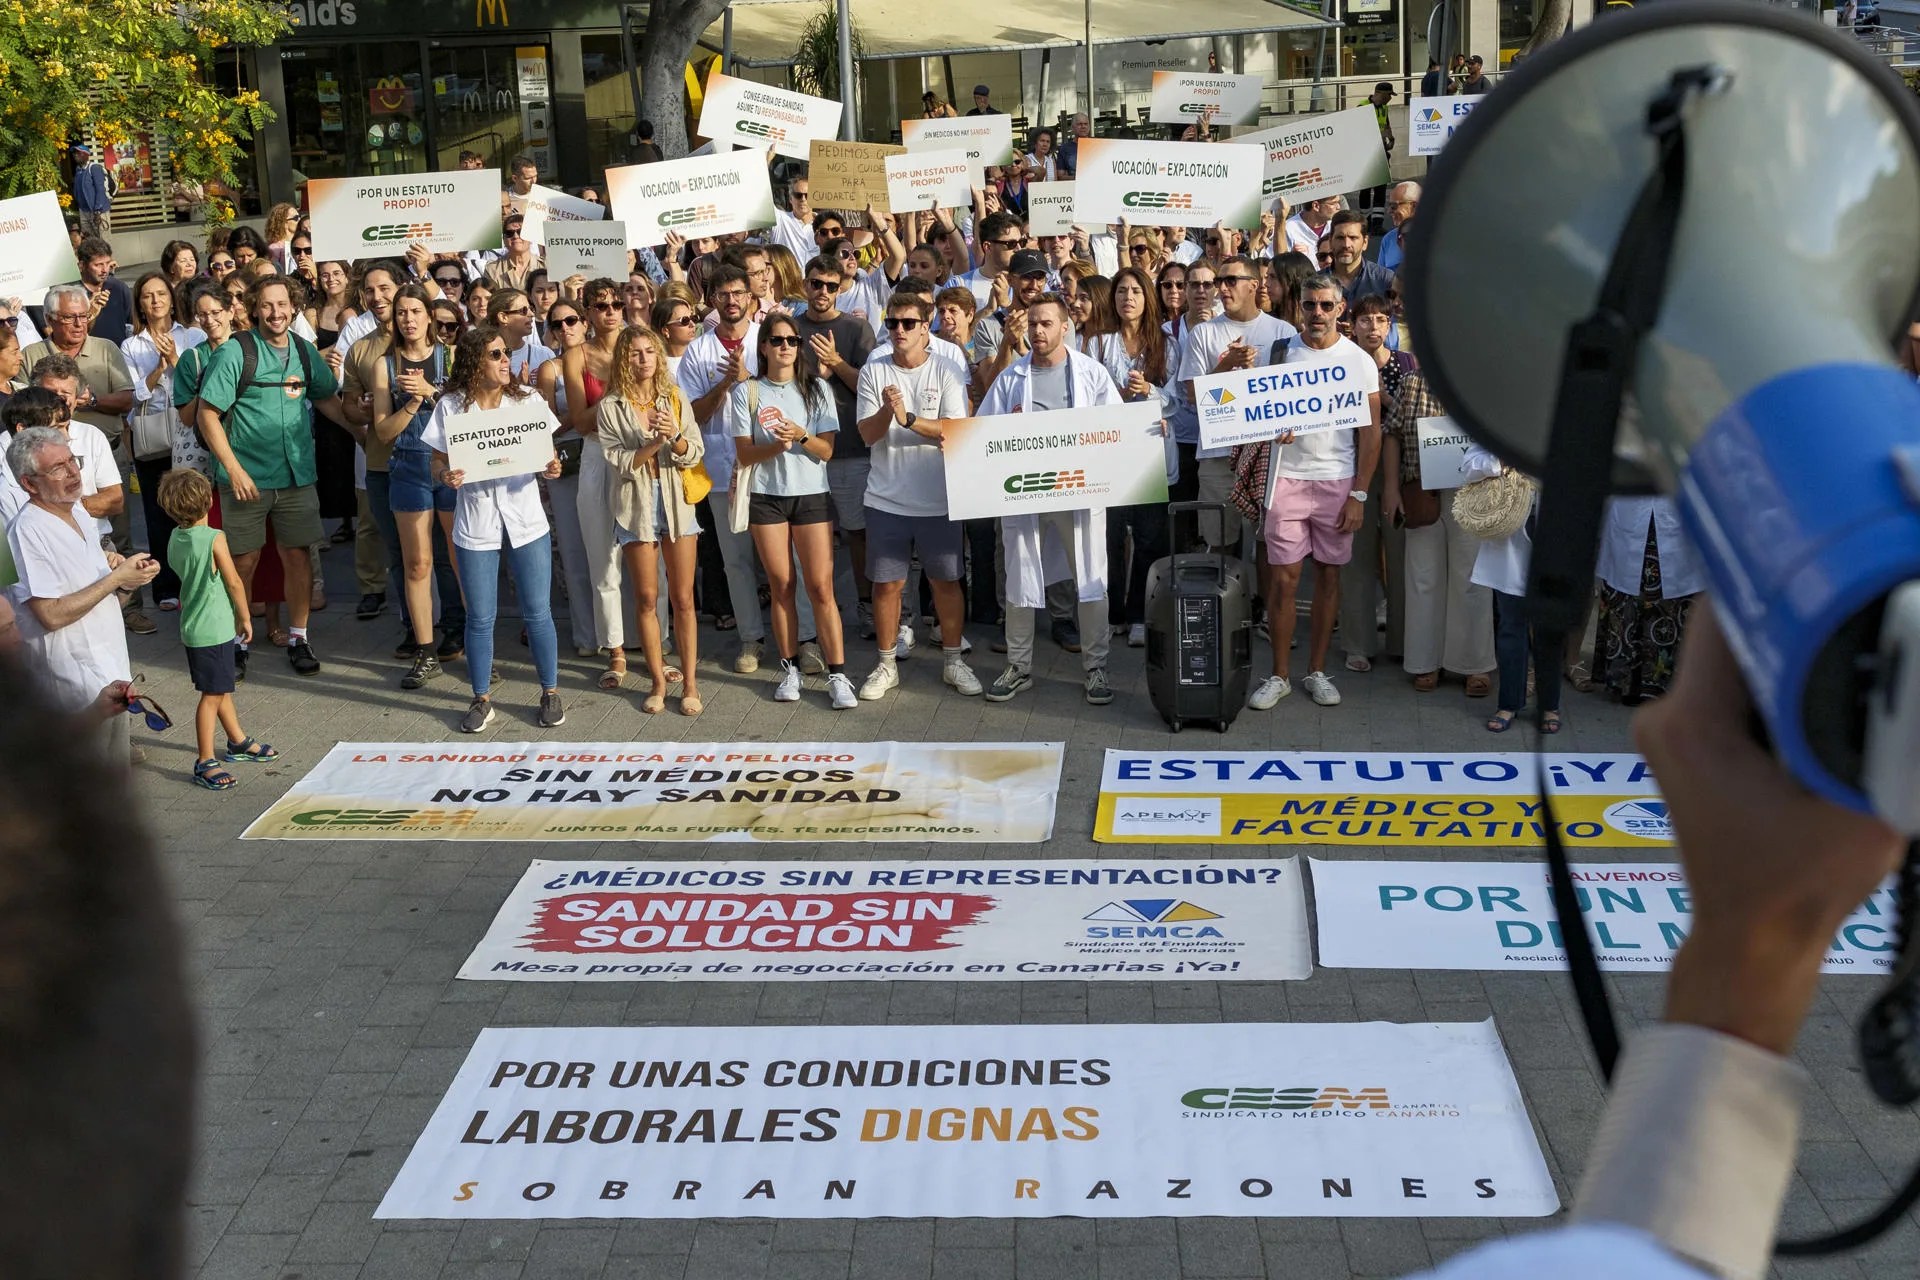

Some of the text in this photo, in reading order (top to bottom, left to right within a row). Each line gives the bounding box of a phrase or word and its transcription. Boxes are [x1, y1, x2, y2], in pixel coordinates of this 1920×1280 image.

[1121, 58, 1187, 70] Premium Reseller
[1193, 88, 1221, 96] PROPIO!
[1205, 80, 1236, 88] ESTATUTO
[735, 119, 787, 141] CESM
[1416, 123, 1441, 131] SEMCA
[1268, 138, 1283, 150] UN
[1284, 125, 1334, 146] ESTATUTO
[818, 144, 870, 160] PEDIMOS
[1269, 144, 1314, 163] PROPIO!
[827, 161, 848, 173] NOS
[909, 170, 922, 178] UN
[924, 165, 967, 177] ESTATUTO
[1111, 158, 1229, 179] VOCACIÓN EXPLOTACIÓN
[639, 168, 741, 199] VOCACIÓN EXPLOTACIÓN
[842, 177, 866, 187] PARA
[910, 177, 945, 188] PROPIO!
[1262, 167, 1323, 195] CESM
[356, 183, 456, 199] ¡POR UN ESTATUTO
[812, 190, 857, 201] CUIDARTE
[383, 198, 431, 210] PROPIO!
[1031, 196, 1073, 207] ¡ESTATUTO
[1122, 191, 1193, 209] CESM
[548, 206, 560, 217] UN
[657, 204, 718, 227] CESM
[361, 222, 433, 242] CESM
[548, 238, 624, 248] ¡ESTATUTO PROPIO
[577, 247, 595, 257] YA!
[1247, 365, 1347, 394] ESTATUTO
[1204, 405, 1237, 417] SEMCA
[1244, 390, 1363, 423] MÉDICO ¡YA!
[1335, 417, 1358, 426] SEMCA
[449, 420, 547, 446] ¡ESTATUTO PROPIO
[477, 435, 522, 451] O NADA!
[984, 429, 1122, 457] ¡SIN MÉDICOS NO HAY SANIDAD!
[1003, 469, 1085, 494] CESM
[1004, 493, 1044, 502] SINDICATO
[1076, 487, 1110, 496] CANARIO
[351, 754, 378, 763] LA
[396, 754, 528, 763] SANIDAD
[675, 754, 715, 763] EN
[724, 754, 855, 763] PELIGRO
[501, 767, 855, 783] SIN MÉDICOS
[1117, 759, 1519, 782] ESTATUTO
[430, 788, 902, 803] NO HAY SANIDAD
[1280, 796, 1495, 817] MÉDICO
[290, 809, 479, 826] CESM
[543, 823, 981, 834] JUNTOS MÁS FUERTES. TE NECESITAMOS.
[543, 864, 1282, 890] ¿MÉDICOS SIN REPRESENTACIÓN?
[1545, 872, 1682, 883] ¡ALVEMOS
[1378, 885, 1529, 912] POR
[557, 899, 955, 922] SANIDAD SIN
[574, 920, 913, 948] SOLUCIÓN
[1086, 926, 1225, 939] SEMCA
[1504, 954, 1651, 963] Asociació Médicos
[490, 961, 1241, 976] Mesa propia de negociación en Canarias ¡Ya!
[489, 1058, 1112, 1089] POR UNAS CONDICIONES
[1180, 1087, 1391, 1110] CESM
[1181, 1110, 1283, 1119] SINDICATO
[1375, 1109, 1461, 1118] CANARIO
[460, 1105, 1102, 1145] LABORALES DIGNAS
